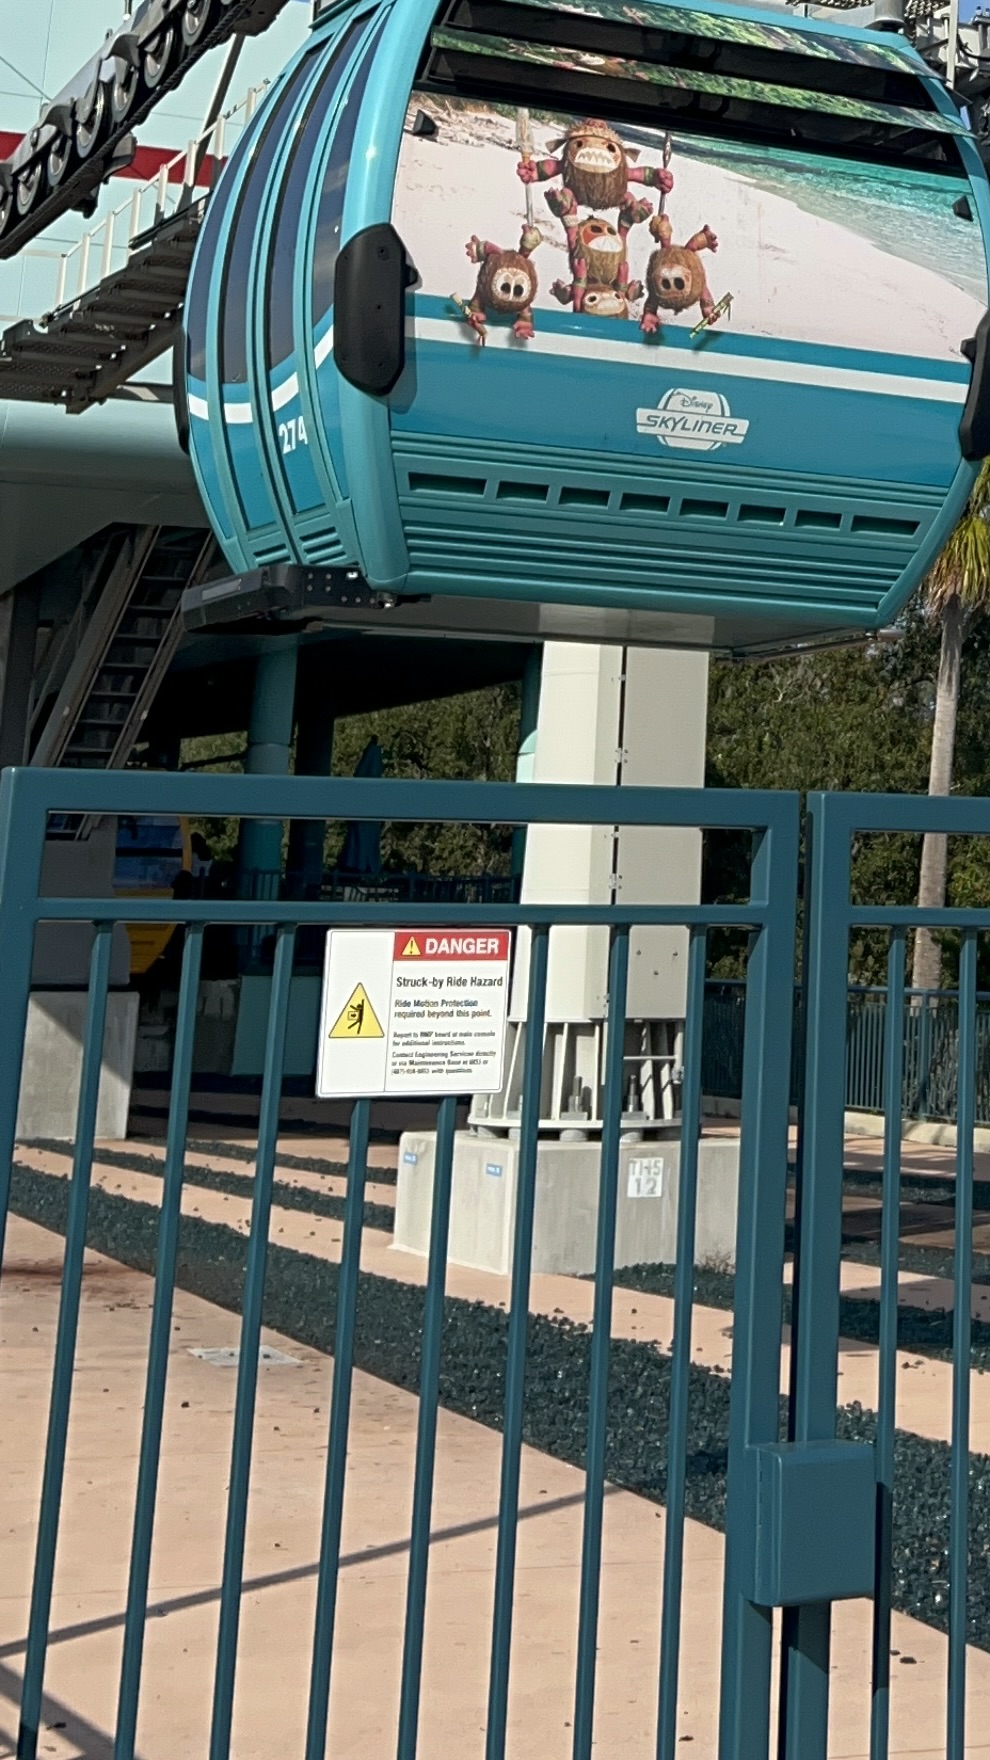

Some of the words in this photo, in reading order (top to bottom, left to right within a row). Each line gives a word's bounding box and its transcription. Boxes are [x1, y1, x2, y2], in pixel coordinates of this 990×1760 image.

[678, 394, 713, 413] Disney
[646, 415, 740, 436] SKYLINER
[279, 415, 308, 454] 274
[425, 938, 499, 954] DANGER
[396, 976, 444, 989] Struck-by
[446, 976, 468, 987] Ride
[470, 976, 503, 987] Hazard
[394, 999, 411, 1007] Ride
[413, 999, 439, 1007] Motion
[441, 999, 478, 1007] Protection
[394, 1010, 425, 1019] required
[428, 1009, 453, 1019] beyond
[456, 1009, 469, 1017] this
[635, 1178, 657, 1195] 12
